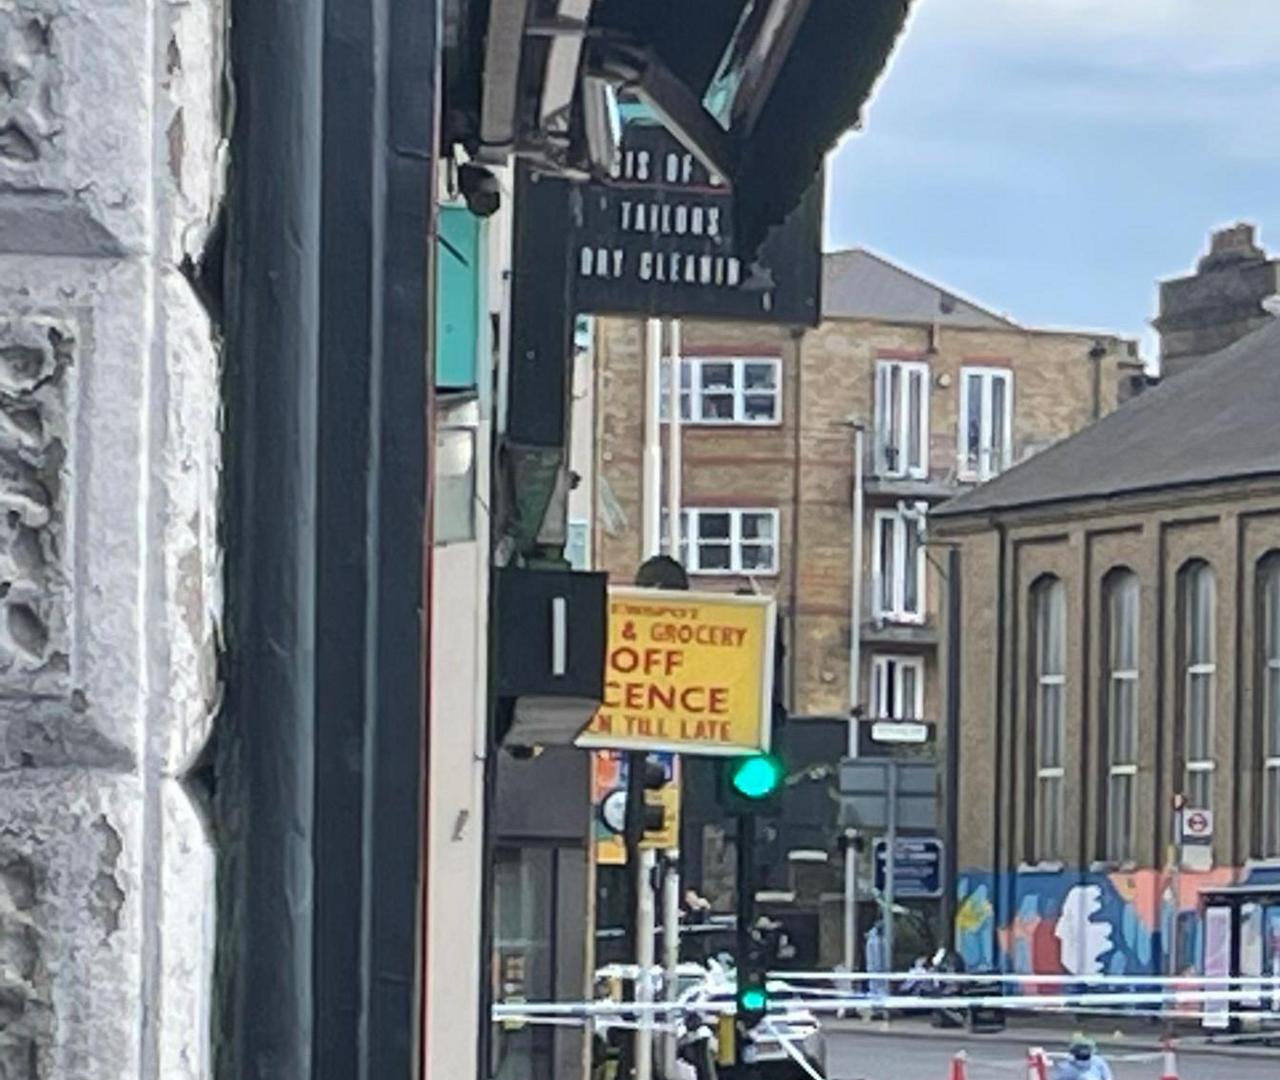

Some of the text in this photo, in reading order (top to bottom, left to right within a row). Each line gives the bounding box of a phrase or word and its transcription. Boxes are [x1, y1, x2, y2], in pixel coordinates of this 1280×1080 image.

[621, 201, 720, 237] TAILORS
[580, 246, 741, 287] DRY CLEANIN
[650, 622, 748, 647] GROCERY
[610, 646, 684, 676] OFF
[623, 716, 670, 738] TILL
[679, 721, 731, 742] LATE
